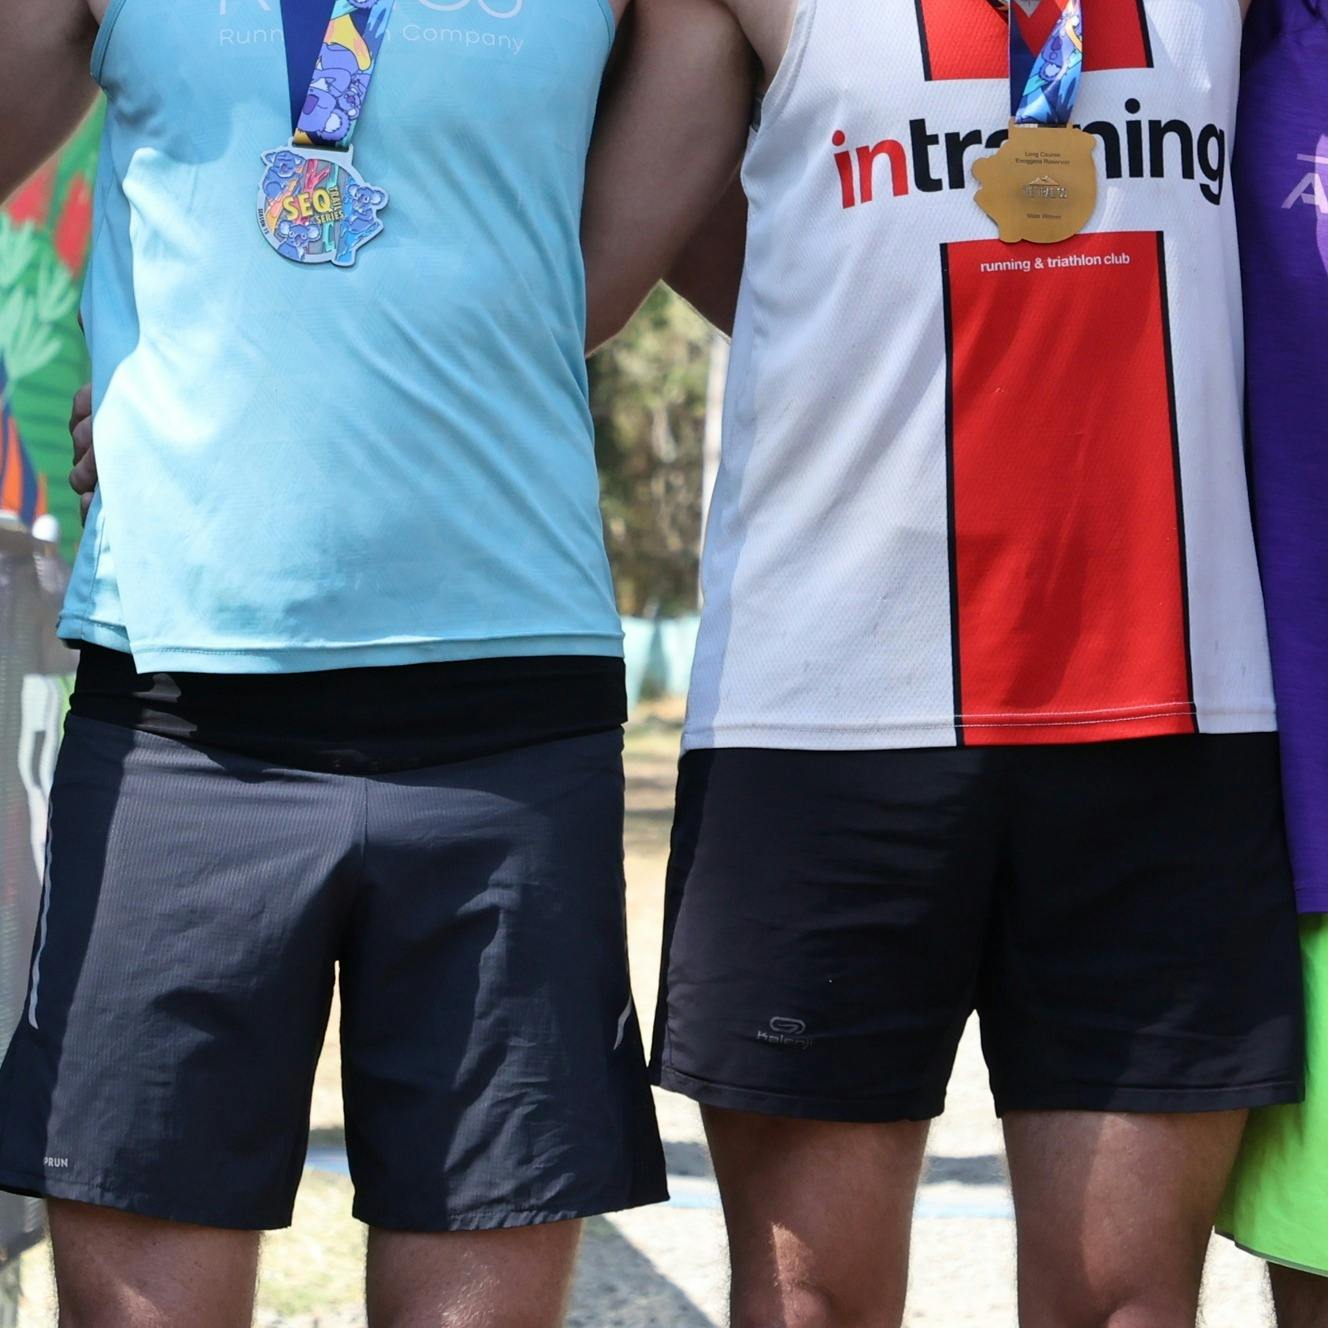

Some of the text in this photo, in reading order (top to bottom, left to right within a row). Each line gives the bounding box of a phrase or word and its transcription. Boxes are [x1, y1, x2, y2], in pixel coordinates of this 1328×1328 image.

[403, 24, 524, 55] Company
[831, 97, 1225, 209] intrning
[282, 188, 332, 221] SEQ
[315, 211, 345, 224] SERIES
[980, 252, 1131, 273] running & triathlon club
